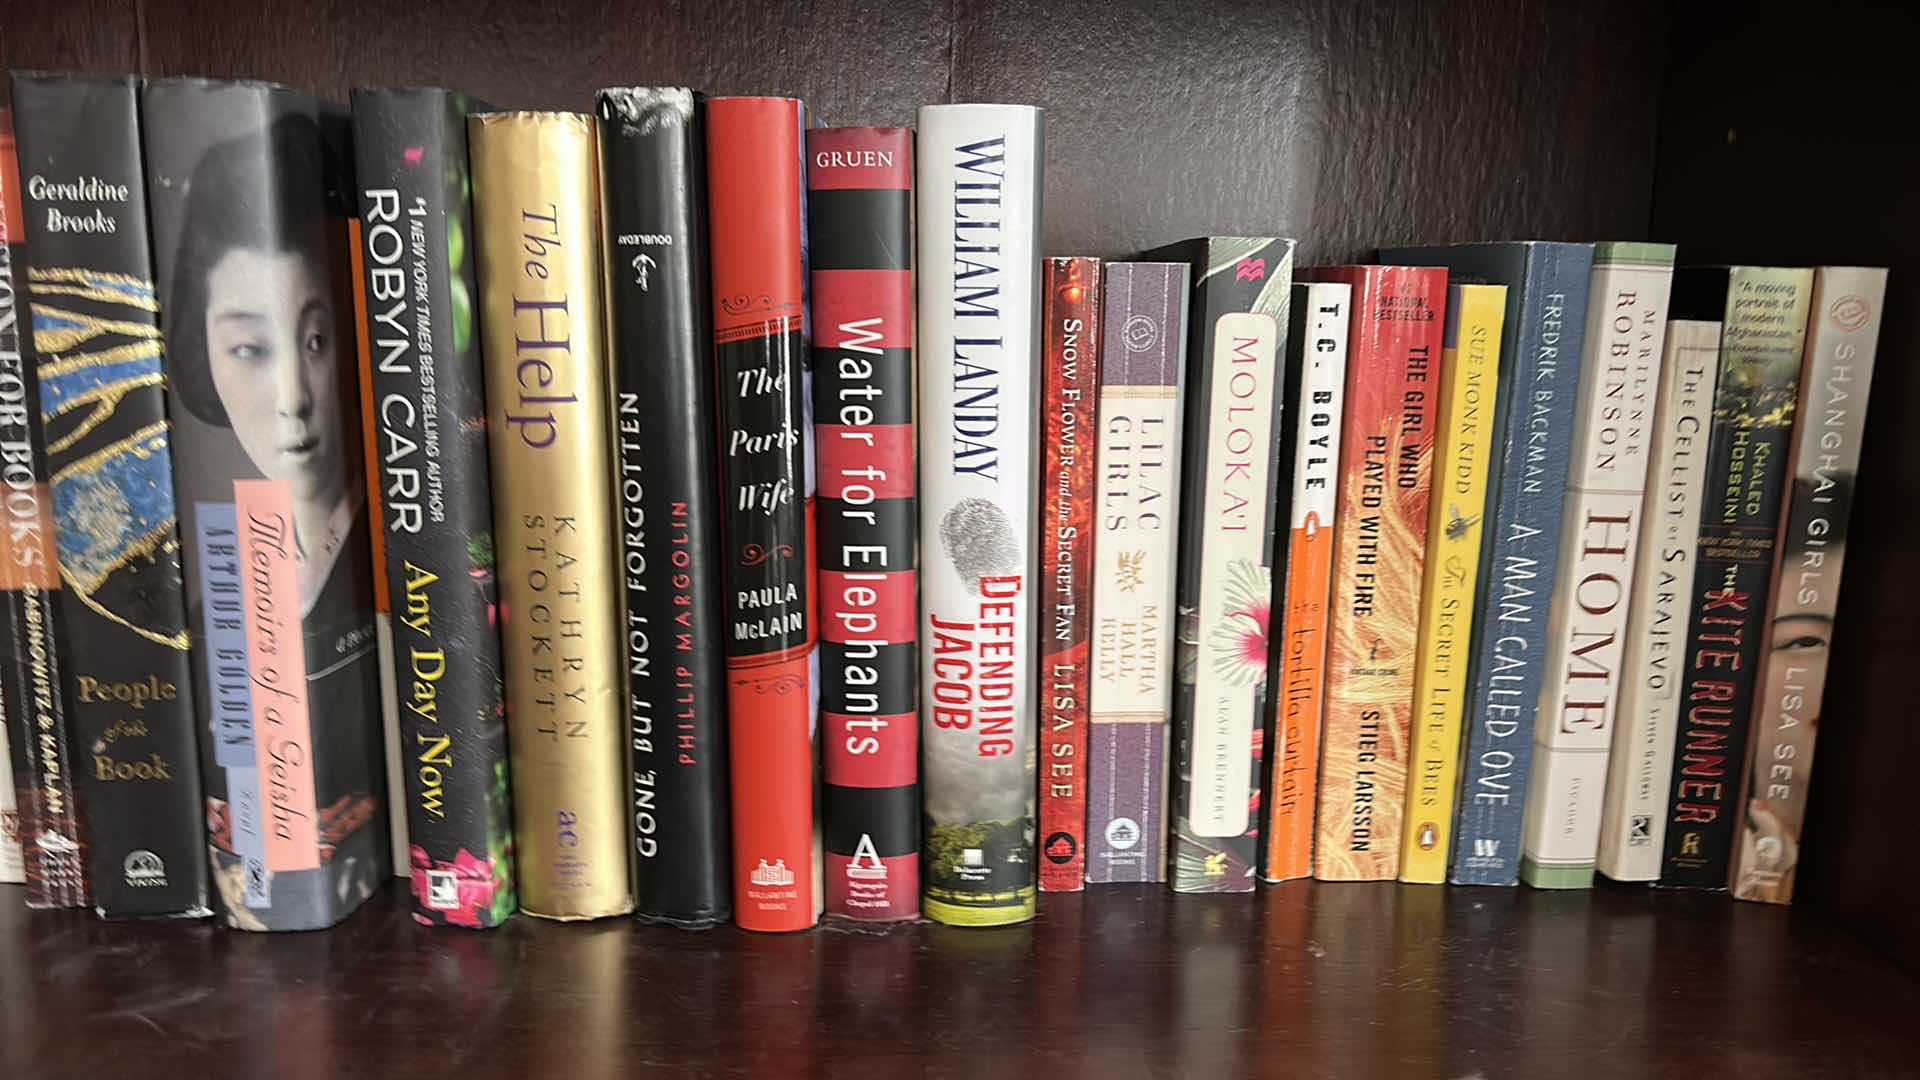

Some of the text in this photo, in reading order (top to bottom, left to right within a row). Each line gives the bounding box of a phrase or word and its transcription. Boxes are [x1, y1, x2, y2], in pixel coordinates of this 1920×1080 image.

[29, 174, 129, 202] Geraldine
[46, 208, 117, 234] Brooks
[816, 151, 893, 168] GRUEN
[409, 219, 426, 257] NEW
[413, 258, 429, 304] YORK
[365, 188, 424, 534] ROBYN CARR
[415, 304, 433, 353] TIMES
[504, 203, 579, 449] The Help
[953, 134, 1005, 484] WILLIAM LANDAY
[419, 354, 440, 457] BESTSELLING
[729, 422, 799, 457] Paris
[737, 367, 786, 398] The
[1305, 390, 1333, 490] BOYLE
[1397, 345, 1429, 489] THE GIRL WHO
[1455, 324, 1487, 495] SUE MONK KIDD
[1523, 293, 1566, 494] FREDRIK BACKMAN
[1597, 289, 1637, 472] ROBINSON
[1625, 309, 1657, 456] MARILYNNE
[1811, 342, 1856, 503] SHANGHAI
[1, 441, 43, 567] BOOKS
[426, 461, 445, 523] AUTHOR
[739, 478, 795, 516] Wife
[835, 317, 889, 755] Water for Elephants
[1058, 471, 1073, 498] and
[1106, 415, 1131, 531] GIRLS
[1138, 418, 1164, 530] LILAC
[1353, 436, 1386, 617] PLAYED WITH FIRE
[1723, 431, 1750, 524] HOSSEINI
[1745, 442, 1772, 516] KHALED
[619, 392, 657, 857] GONE, BUT NOT FORGOTTEN
[738, 583, 798, 609] PAULA
[1559, 509, 1633, 735] HOME
[1721, 563, 1739, 600] THE
[1796, 517, 1830, 608] GIRLS
[205, 527, 254, 747] ARTHUR GOLDEN
[246, 511, 310, 842] Memoirs of a Geisha
[400, 558, 453, 818] Any Day Now
[524, 514, 558, 743] STOCKETT
[552, 515, 588, 740] KATHRYN
[671, 502, 697, 766] PHILLIP MARGOLIN
[931, 613, 975, 731] JACOB
[977, 575, 1022, 758] DEFENDING
[1098, 617, 1117, 683] KELLY
[1119, 622, 1137, 677] HALL
[1139, 604, 1158, 695] MARTHA
[1474, 523, 1542, 806] A MAN CALLED OVE
[1695, 591, 1751, 671] KITE
[23, 582, 52, 710] RABINOWITZ
[38, 733, 64, 814] KAPLAN
[77, 674, 177, 709] People
[1051, 664, 1075, 798] LISA SEE
[1674, 679, 1738, 824] RUNNER
[1767, 666, 1808, 801] LISA SEE
[94, 752, 172, 782] Book
[1213, 695, 1230, 823] ALAN BRENNERT
[1351, 710, 1380, 852] STIEG LARSSON
